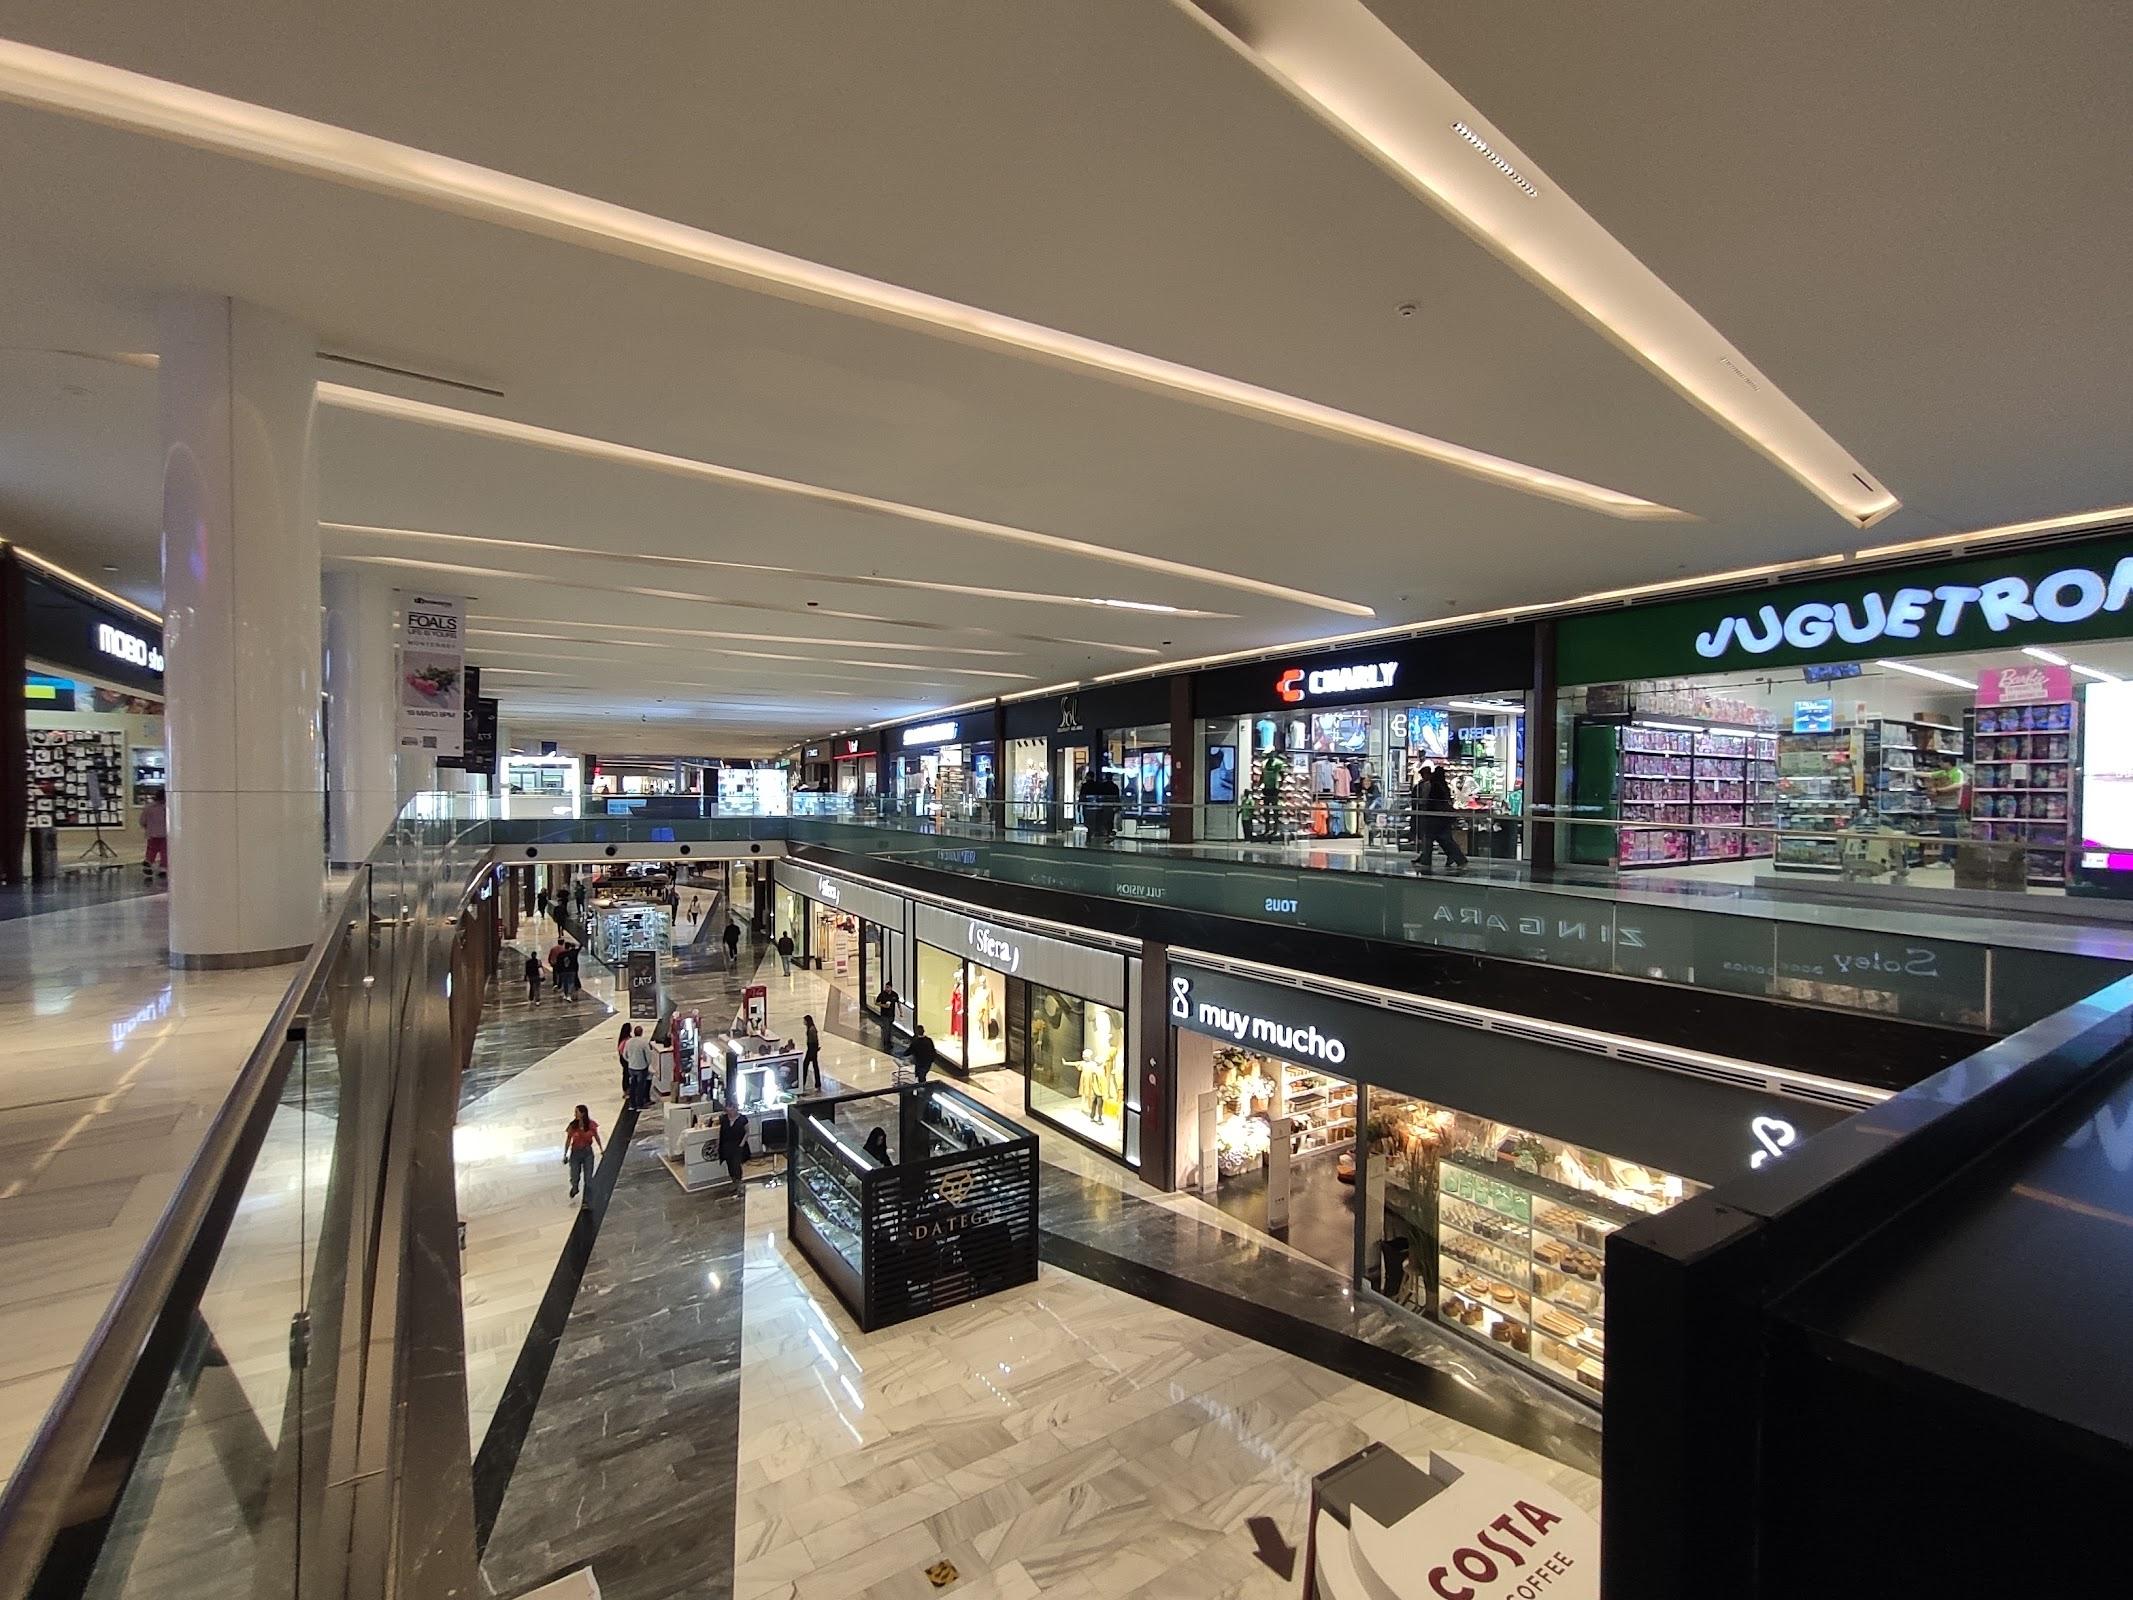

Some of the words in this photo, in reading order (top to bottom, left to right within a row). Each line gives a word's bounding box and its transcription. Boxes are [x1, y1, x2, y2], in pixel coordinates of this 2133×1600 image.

[408, 614, 457, 630] FOALS
[148, 646, 165, 672] sho
[1308, 661, 1399, 694] CHARLY
[633, 976, 653, 988] CATS
[1199, 1003, 1250, 1040] muy
[1252, 1017, 1346, 1063] mucho
[1428, 1500, 1563, 1600] COSTA
